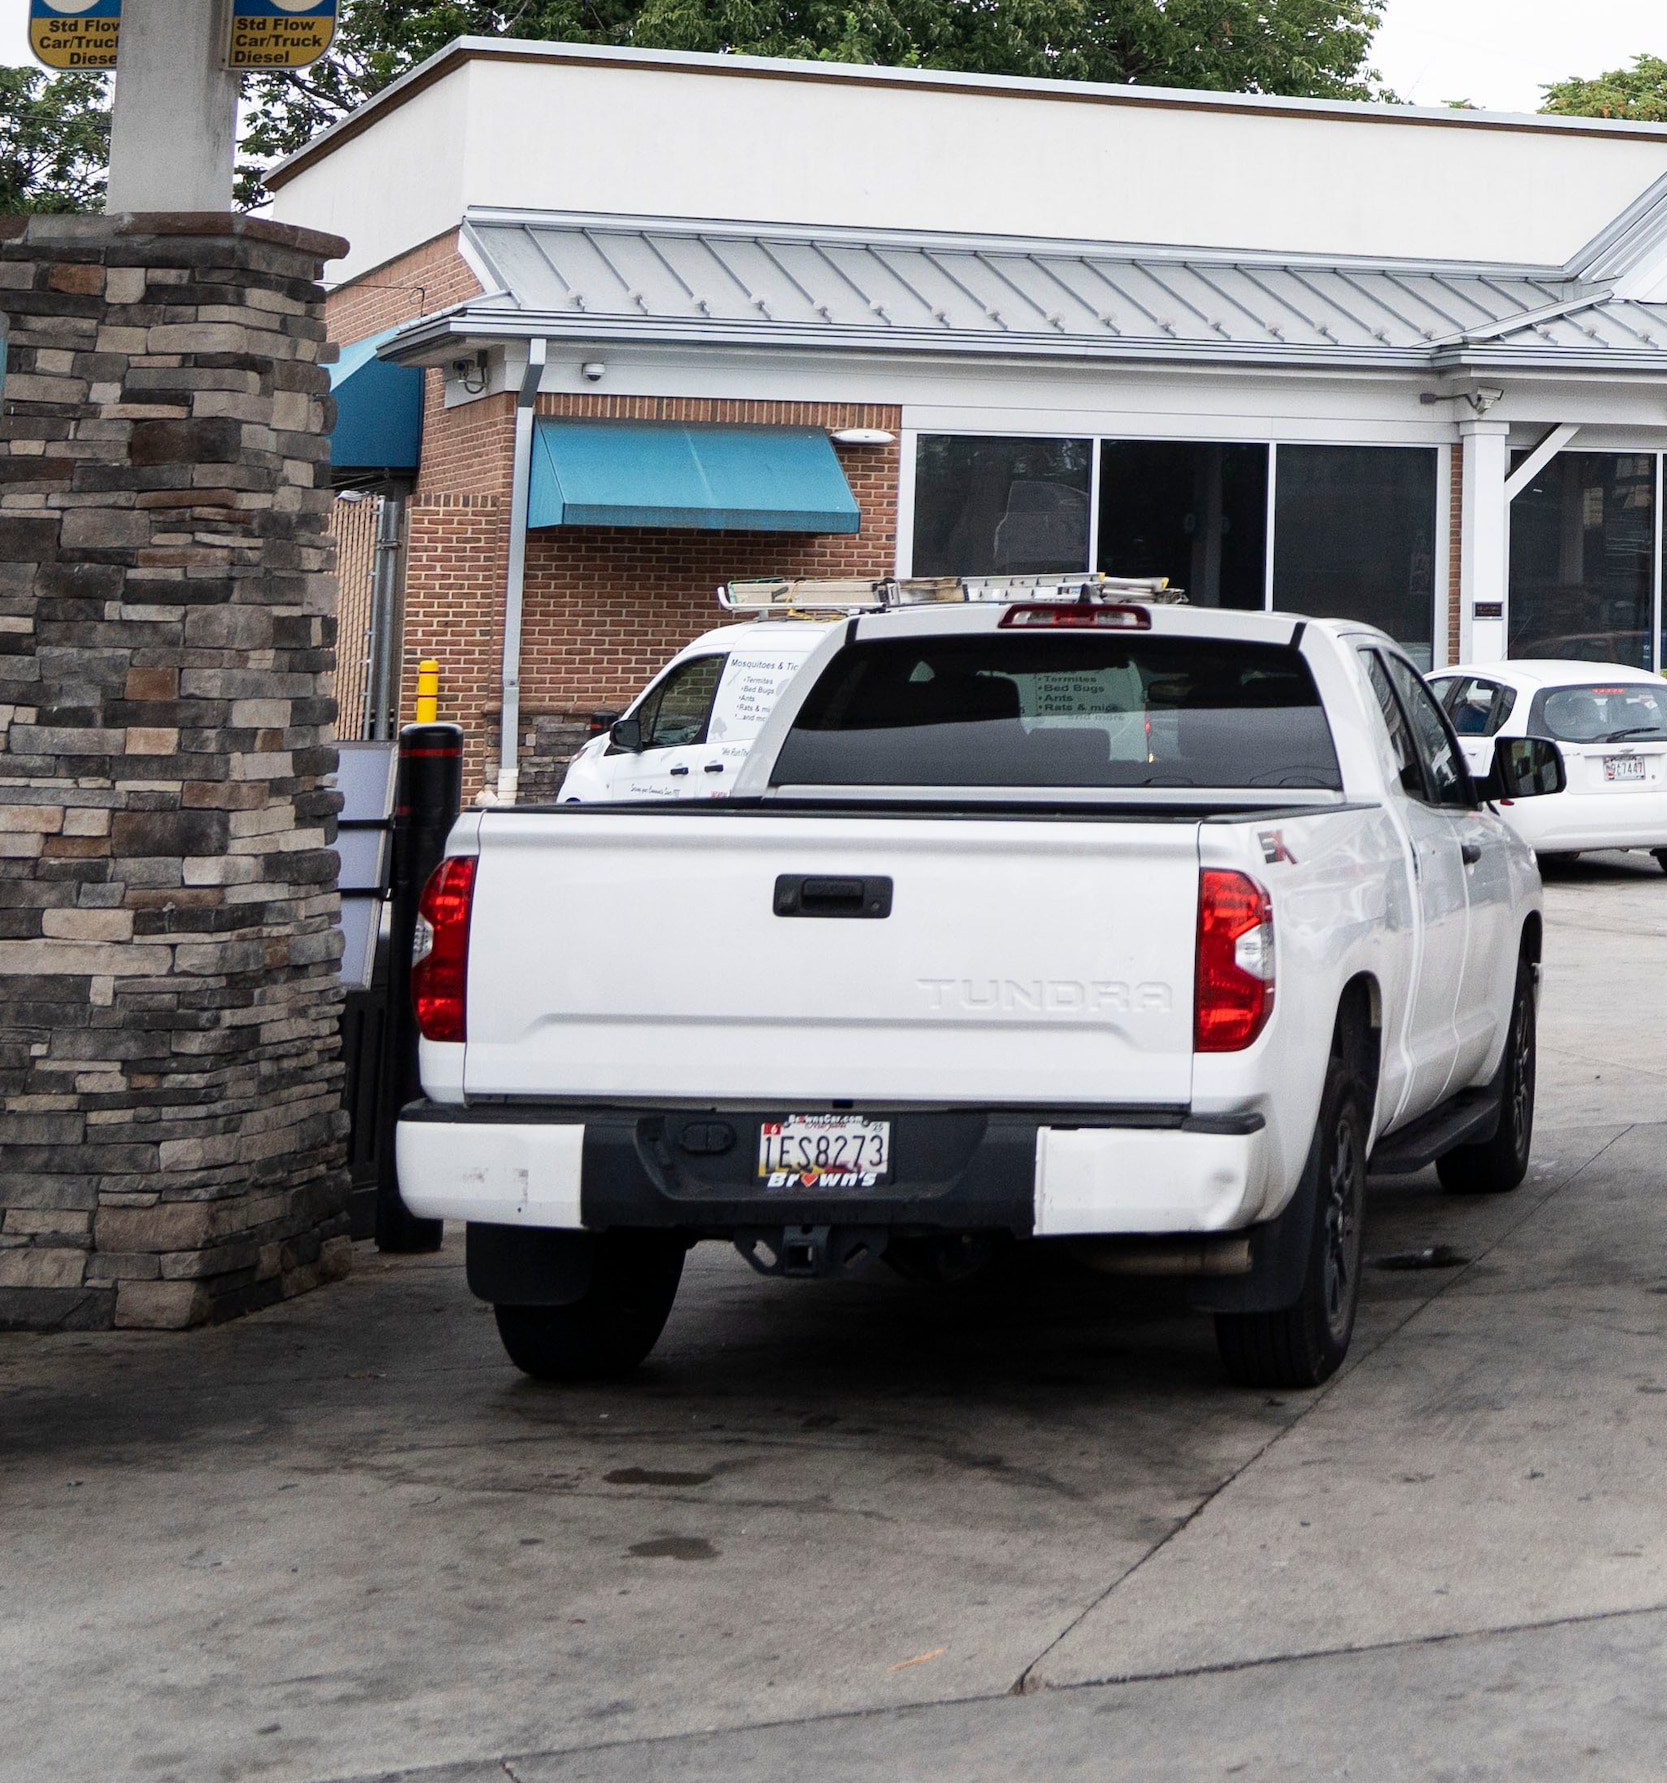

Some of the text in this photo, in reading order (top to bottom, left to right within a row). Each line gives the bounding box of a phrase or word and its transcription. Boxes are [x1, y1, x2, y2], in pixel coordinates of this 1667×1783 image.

[49, 20, 81, 32] Std
[237, 18, 315, 31] Std Flow
[235, 34, 322, 48] Car/Truck
[70, 52, 117, 65] Diese
[234, 50, 290, 63] Diesel
[731, 659, 799, 672] Mosquitoes & Tic
[746, 676, 773, 685] Termites
[1044, 675, 1097, 683] Termites
[757, 687, 775, 695] Bugs
[1073, 684, 1105, 694] Bugs
[1044, 694, 1074, 702] Ants
[916, 978, 1174, 1013] TUNDRA
[765, 1135, 884, 1170] 1ES8273
